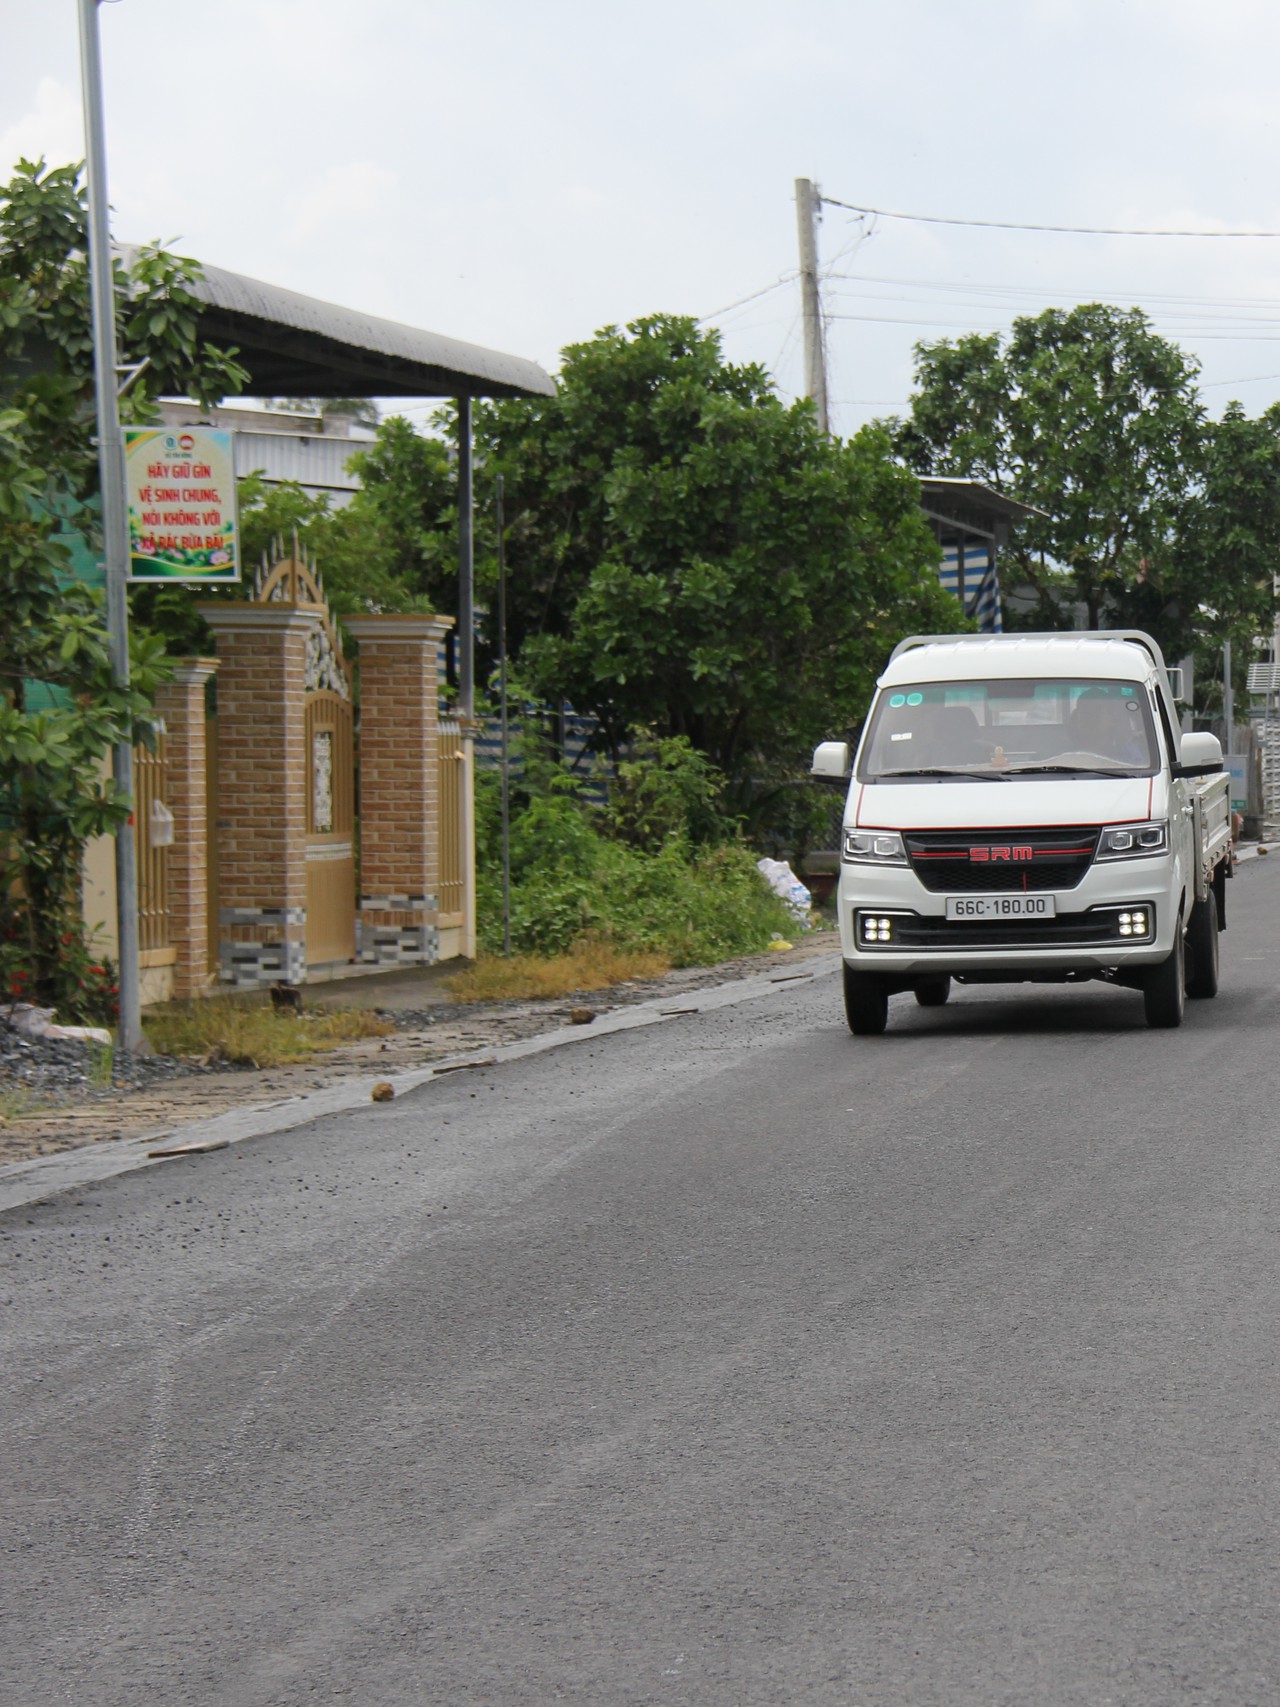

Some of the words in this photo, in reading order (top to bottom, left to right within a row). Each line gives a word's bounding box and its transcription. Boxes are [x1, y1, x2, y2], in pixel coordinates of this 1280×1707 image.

[147, 461, 170, 479] HÃY
[192, 462, 211, 479] GÌN
[139, 485, 152, 505] VỆ
[155, 488, 180, 503] SINH
[182, 488, 222, 505] CHUNG,
[142, 509, 161, 526] NÓI
[163, 508, 200, 526] KHÔNG
[202, 508, 221, 526] VỚI
[969, 846, 1033, 862] SRM
[955, 899, 1045, 915] 66C-180.00
